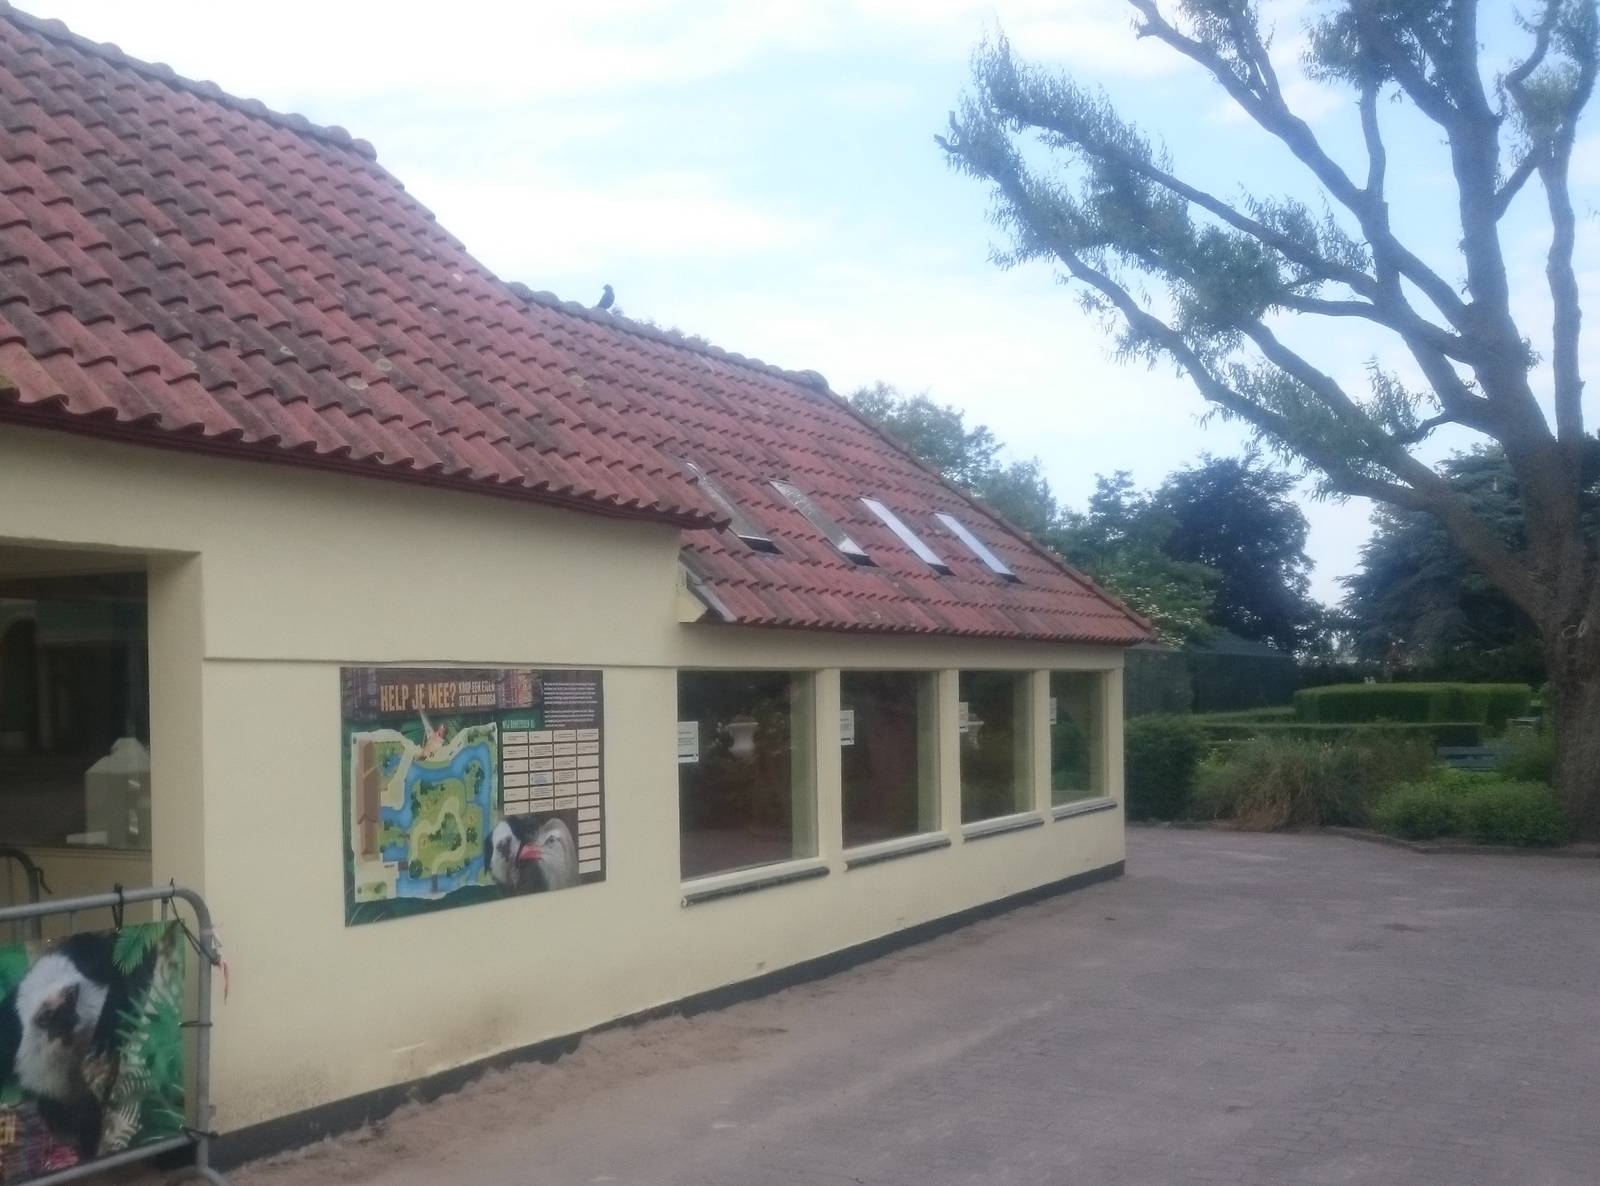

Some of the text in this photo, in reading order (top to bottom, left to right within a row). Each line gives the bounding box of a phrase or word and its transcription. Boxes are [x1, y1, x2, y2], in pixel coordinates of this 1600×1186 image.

[380, 684, 409, 712] HELP
[411, 683, 425, 710] JE
[428, 681, 457, 709] MEE?
